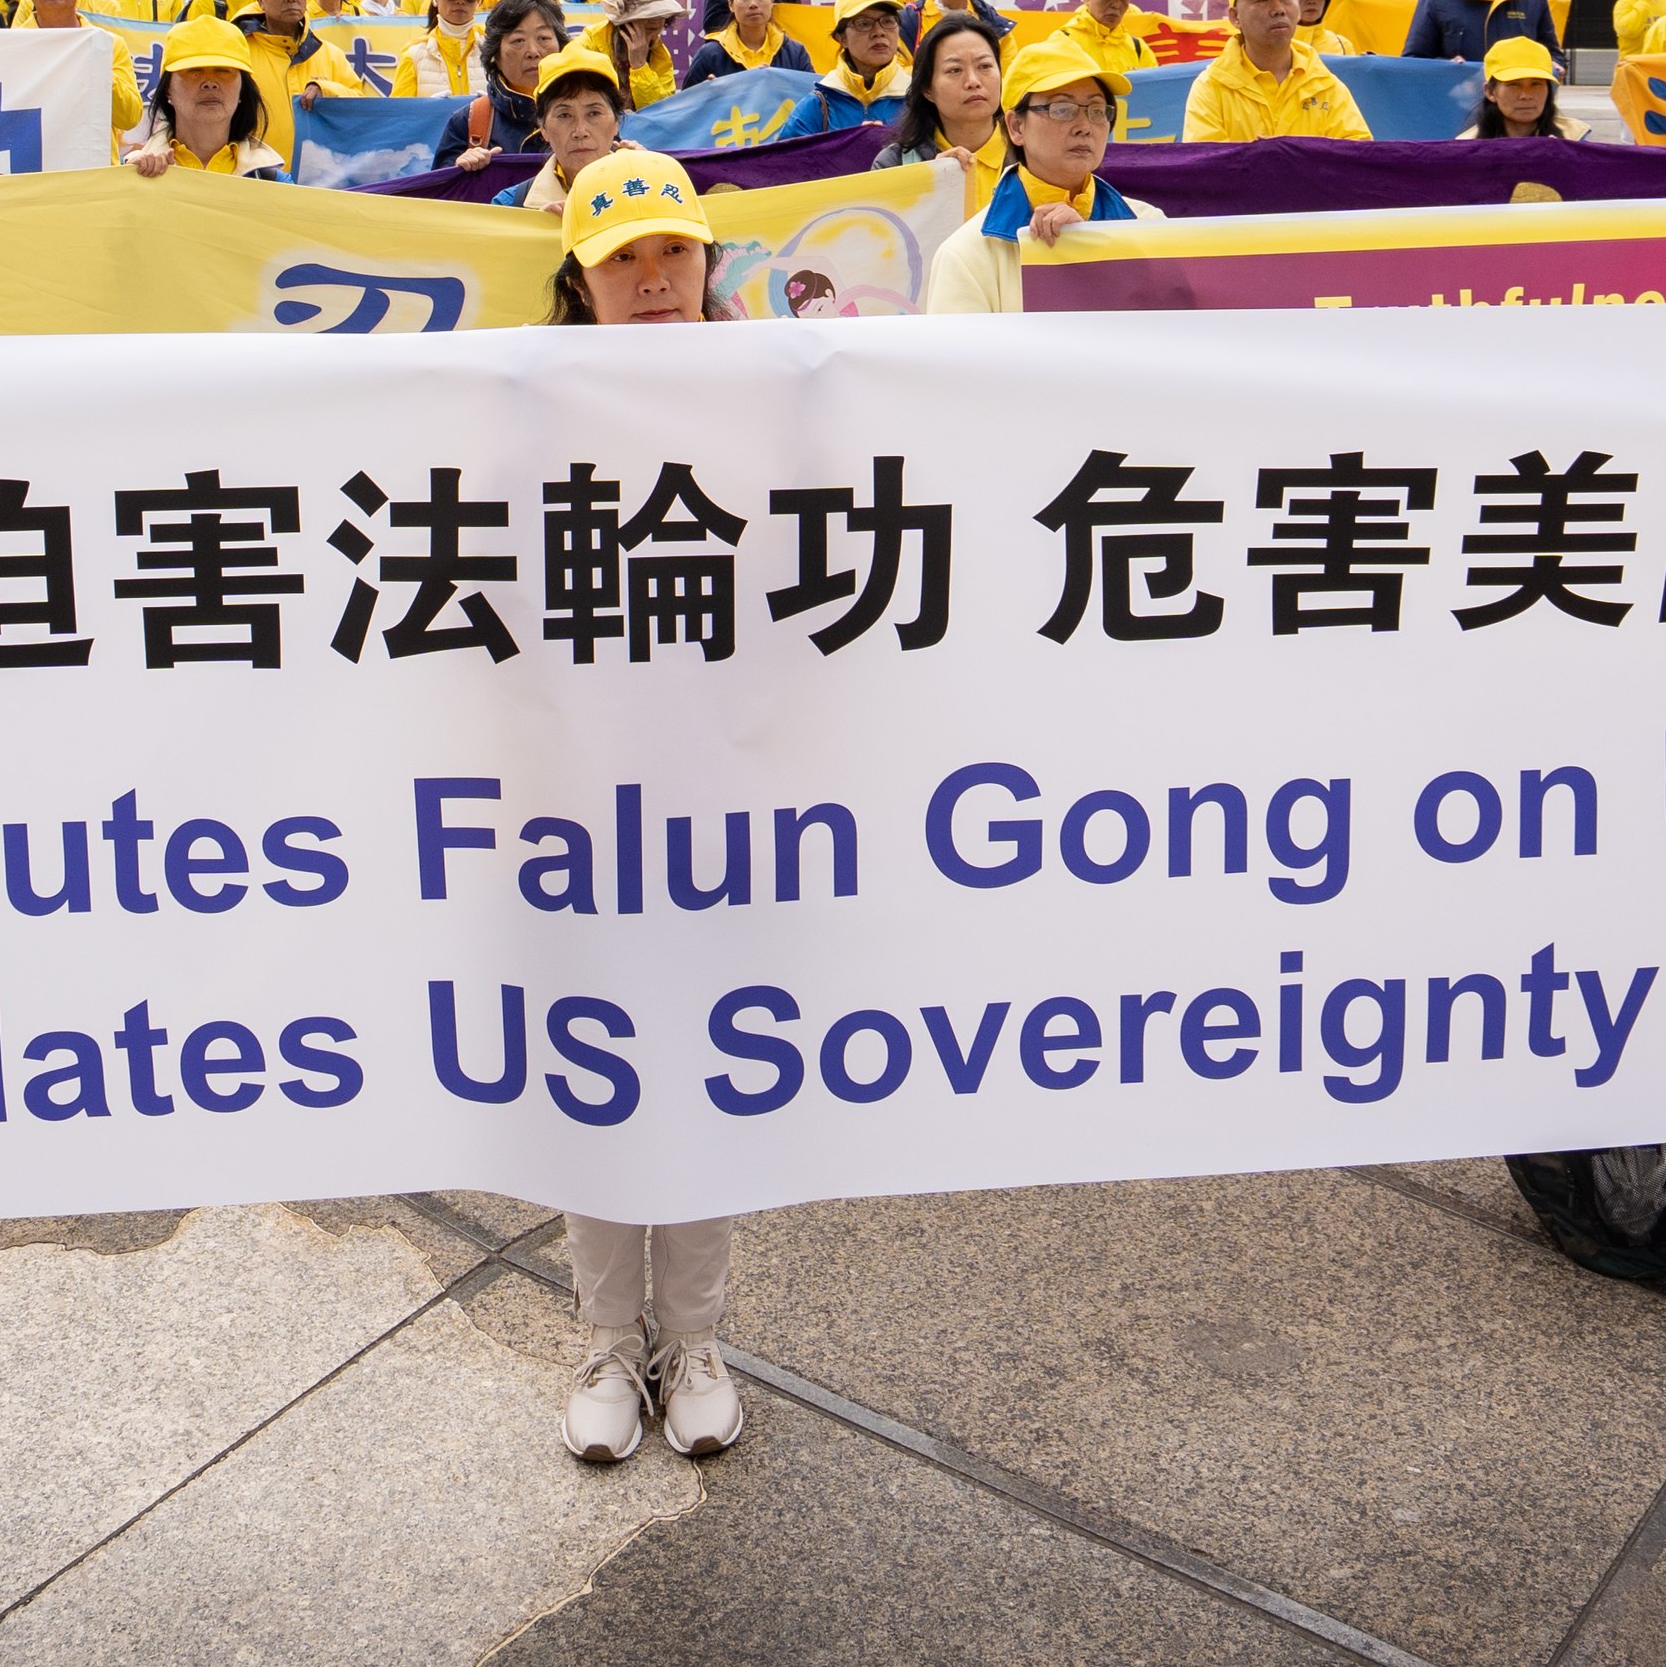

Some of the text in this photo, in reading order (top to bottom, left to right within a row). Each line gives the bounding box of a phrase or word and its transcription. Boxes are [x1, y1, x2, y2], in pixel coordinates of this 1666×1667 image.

[590, 177, 684, 217] 真善忍
[412, 777, 859, 915] Falun
[924, 761, 1351, 906] Gong
[1412, 765, 1598, 864] on
[427, 980, 641, 1126] US
[703, 943, 1659, 1116] Sovereignty
